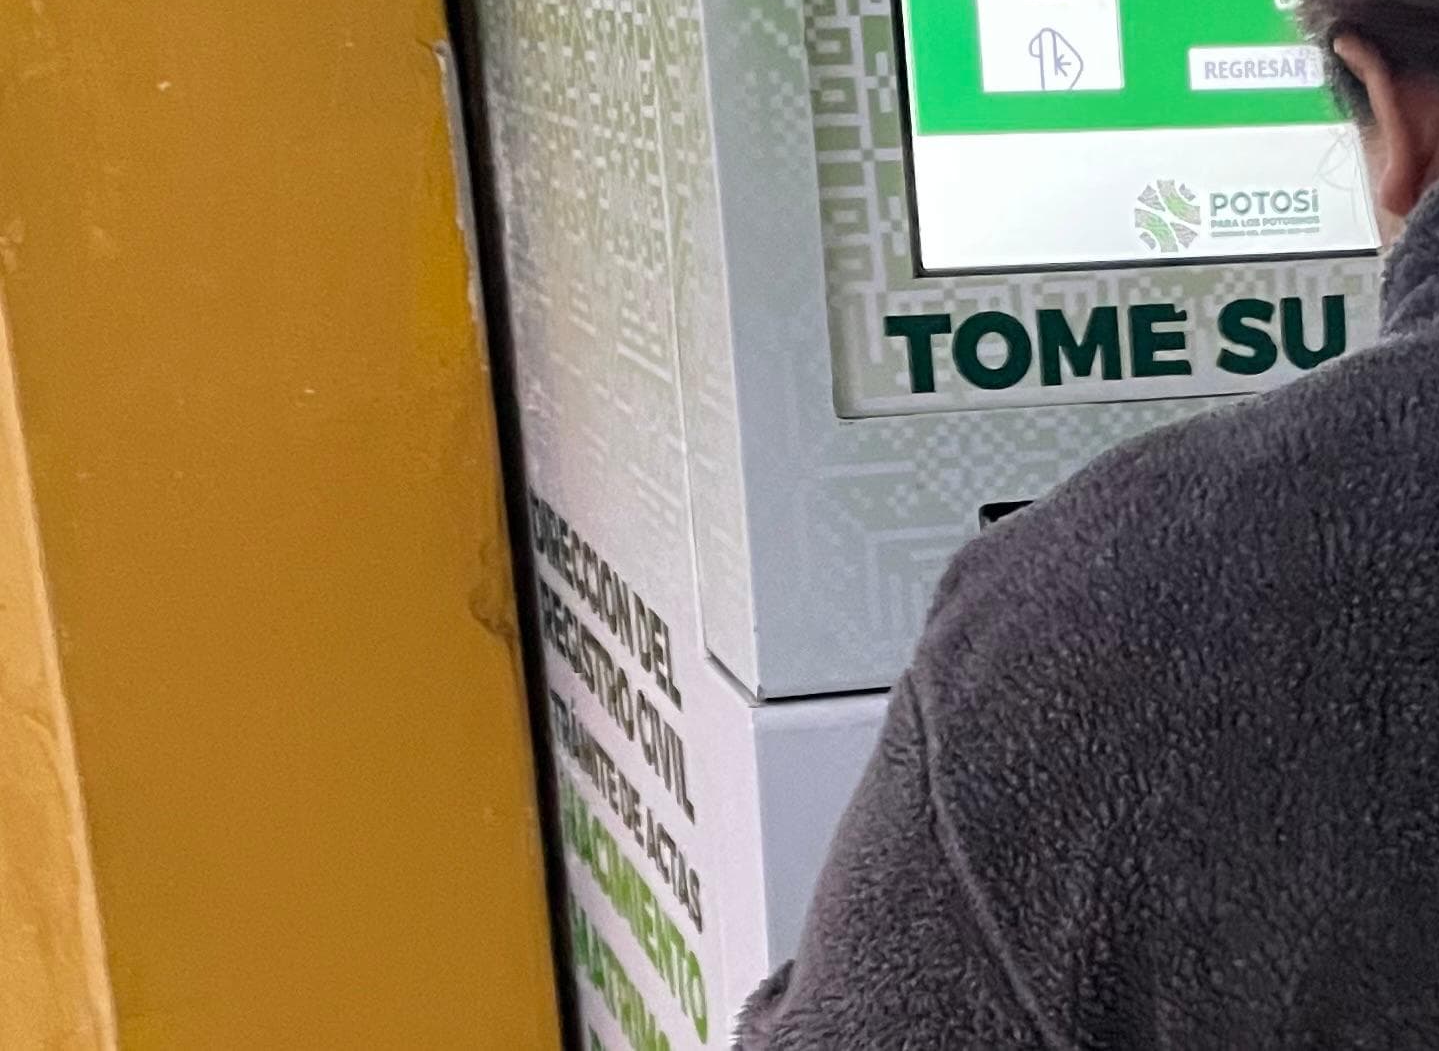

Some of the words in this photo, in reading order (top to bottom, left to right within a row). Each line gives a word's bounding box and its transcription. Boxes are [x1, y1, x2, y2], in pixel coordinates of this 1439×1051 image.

[1204, 58, 1307, 80] REGRESAR
[884, 302, 1192, 394] TOME
[1216, 294, 1347, 376] SU
[538, 575, 635, 742] REGISTRO
[635, 688, 696, 826] CIVIL
[631, 590, 683, 712] DEL
[646, 805, 703, 935] ACTAS
